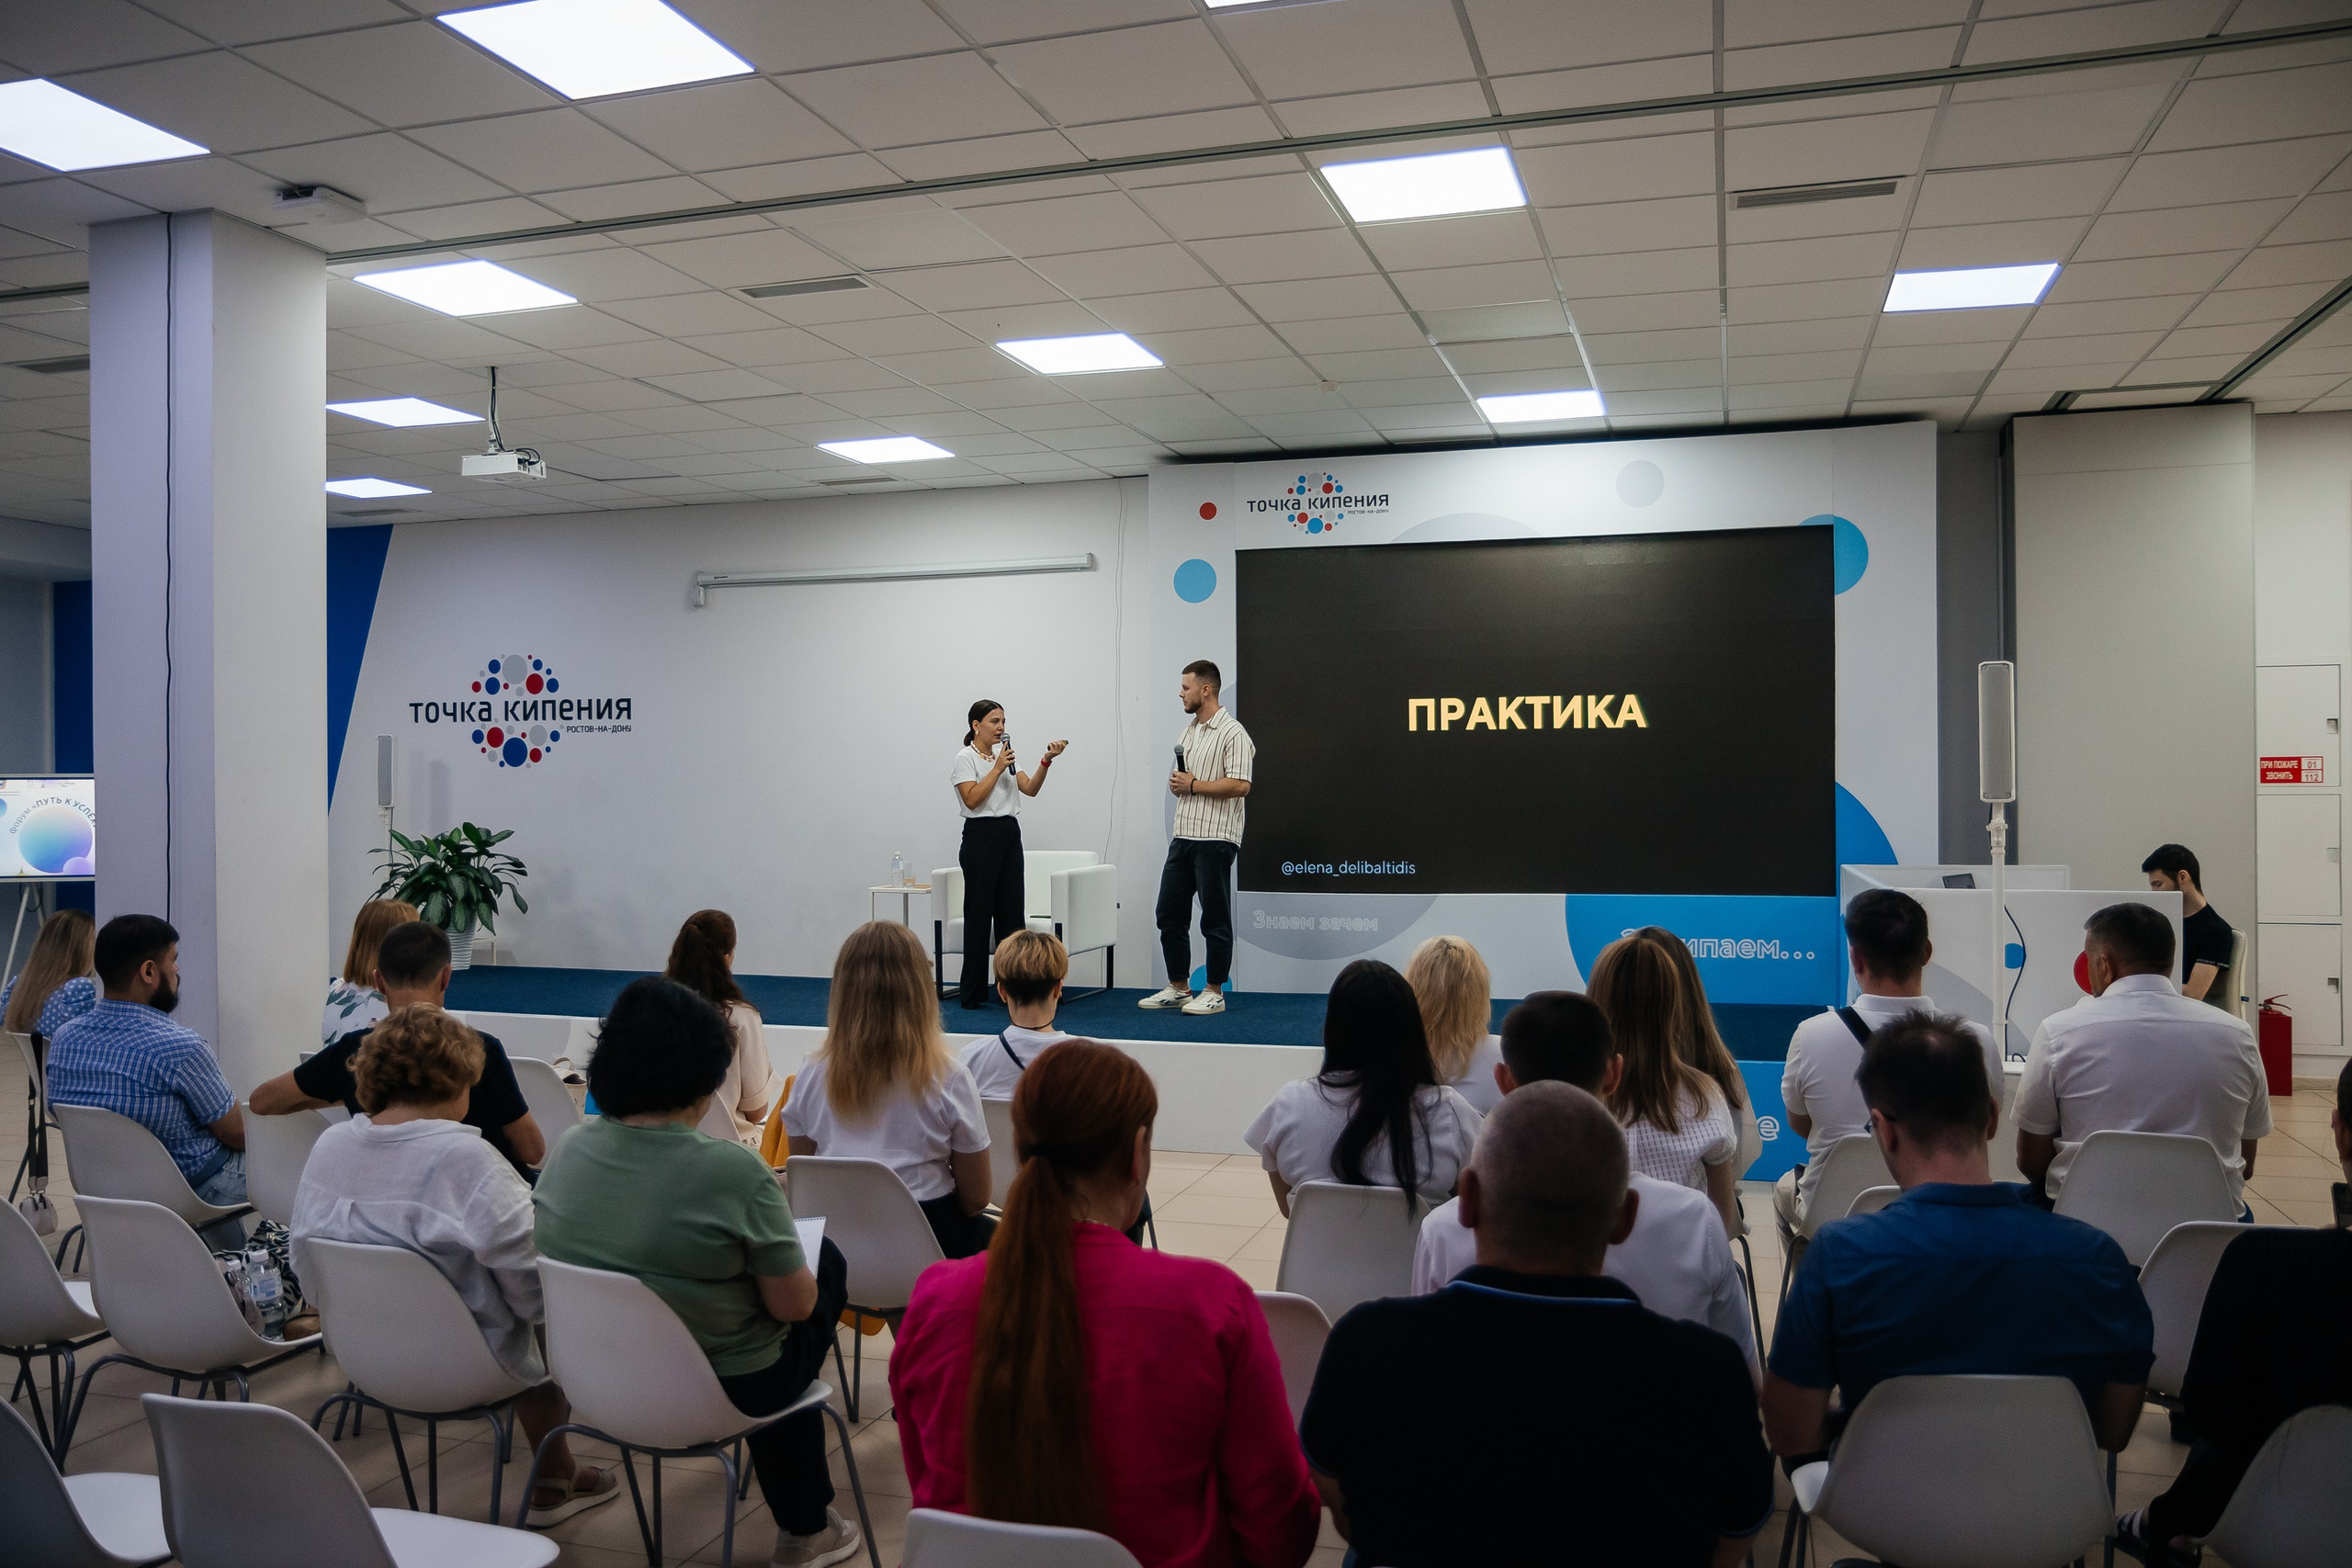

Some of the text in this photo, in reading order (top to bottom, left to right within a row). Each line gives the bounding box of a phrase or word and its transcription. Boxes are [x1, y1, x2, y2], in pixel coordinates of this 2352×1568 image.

[1247, 493, 1389, 513] точка кипения
[409, 697, 632, 724] точка кипения
[1408, 694, 1647, 731] ПРАКТИКА
[566, 724, 632, 733] РОСТОВ-НА-ДОНУ
[2260, 760, 2299, 769] ПРИ ПОЖАРЕ
[2307, 761, 2317, 769] 01
[2266, 772, 2293, 780] ЗВОНИТЬ
[2304, 773, 2319, 782] 112
[1281, 860, 1416, 877] @elena_delibaltidis
[1252, 909, 1378, 931] Знаем зачем
